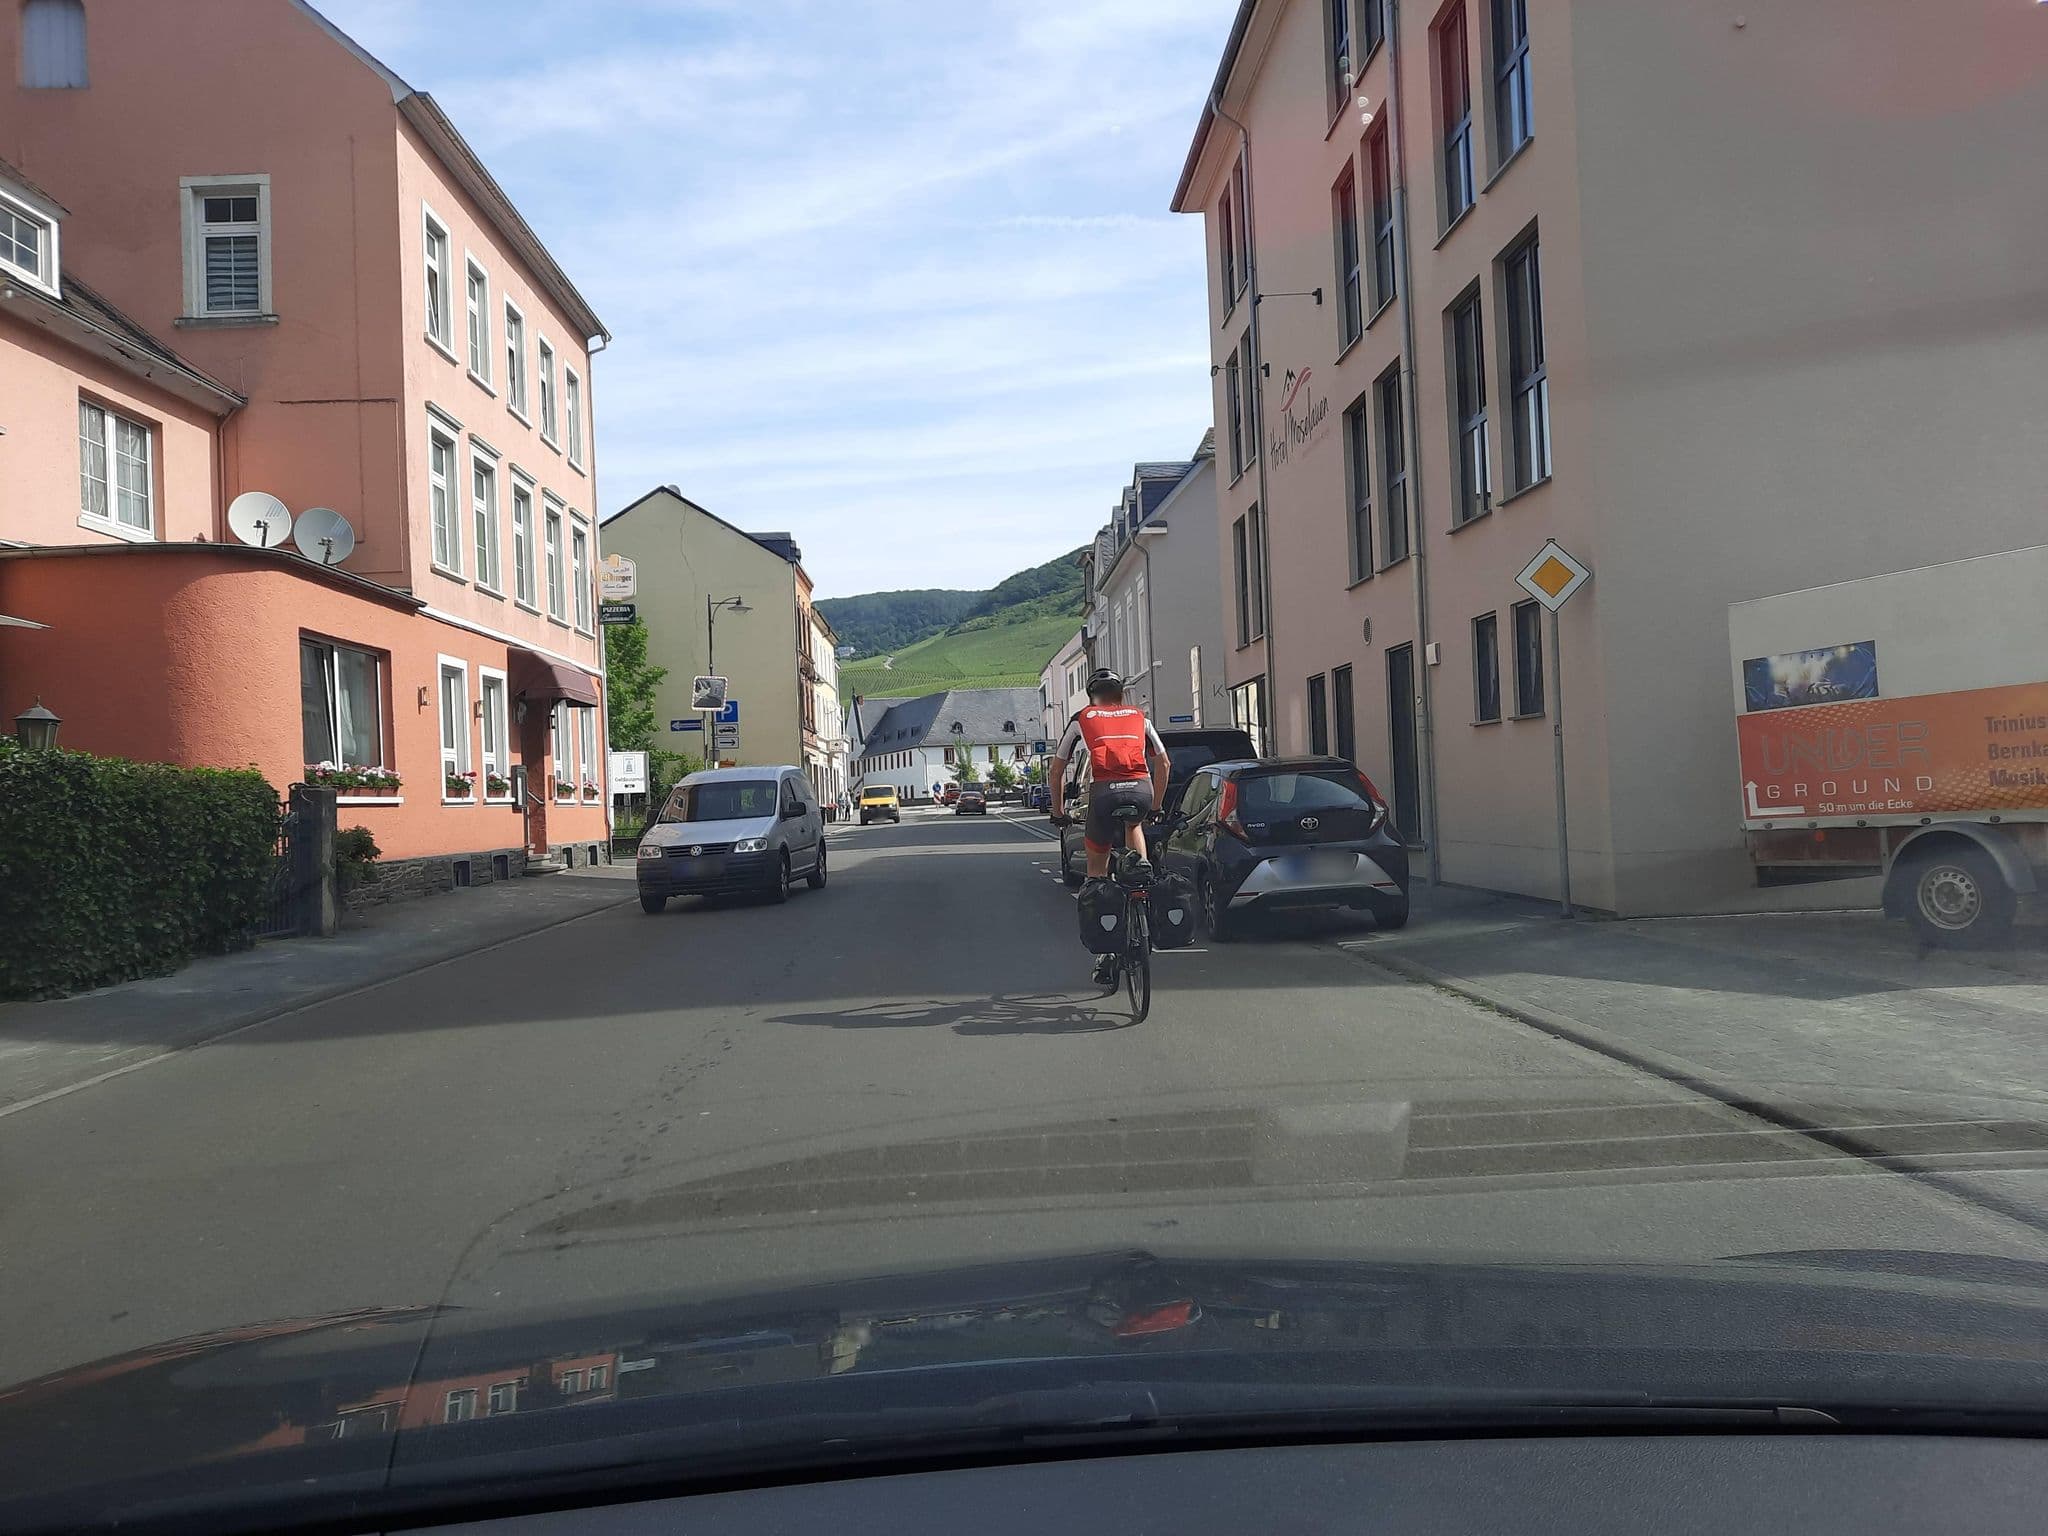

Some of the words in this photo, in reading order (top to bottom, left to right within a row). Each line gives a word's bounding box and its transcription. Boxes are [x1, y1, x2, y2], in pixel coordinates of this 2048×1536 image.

[1270, 413, 1289, 472] Hotel
[721, 703, 733, 720] P
[1762, 720, 1931, 776] UNDER
[1767, 776, 1933, 799] GROUND
[1850, 803, 1866, 812] um
[1868, 800, 1884, 810] die
[1887, 799, 1913, 809] Ecke
